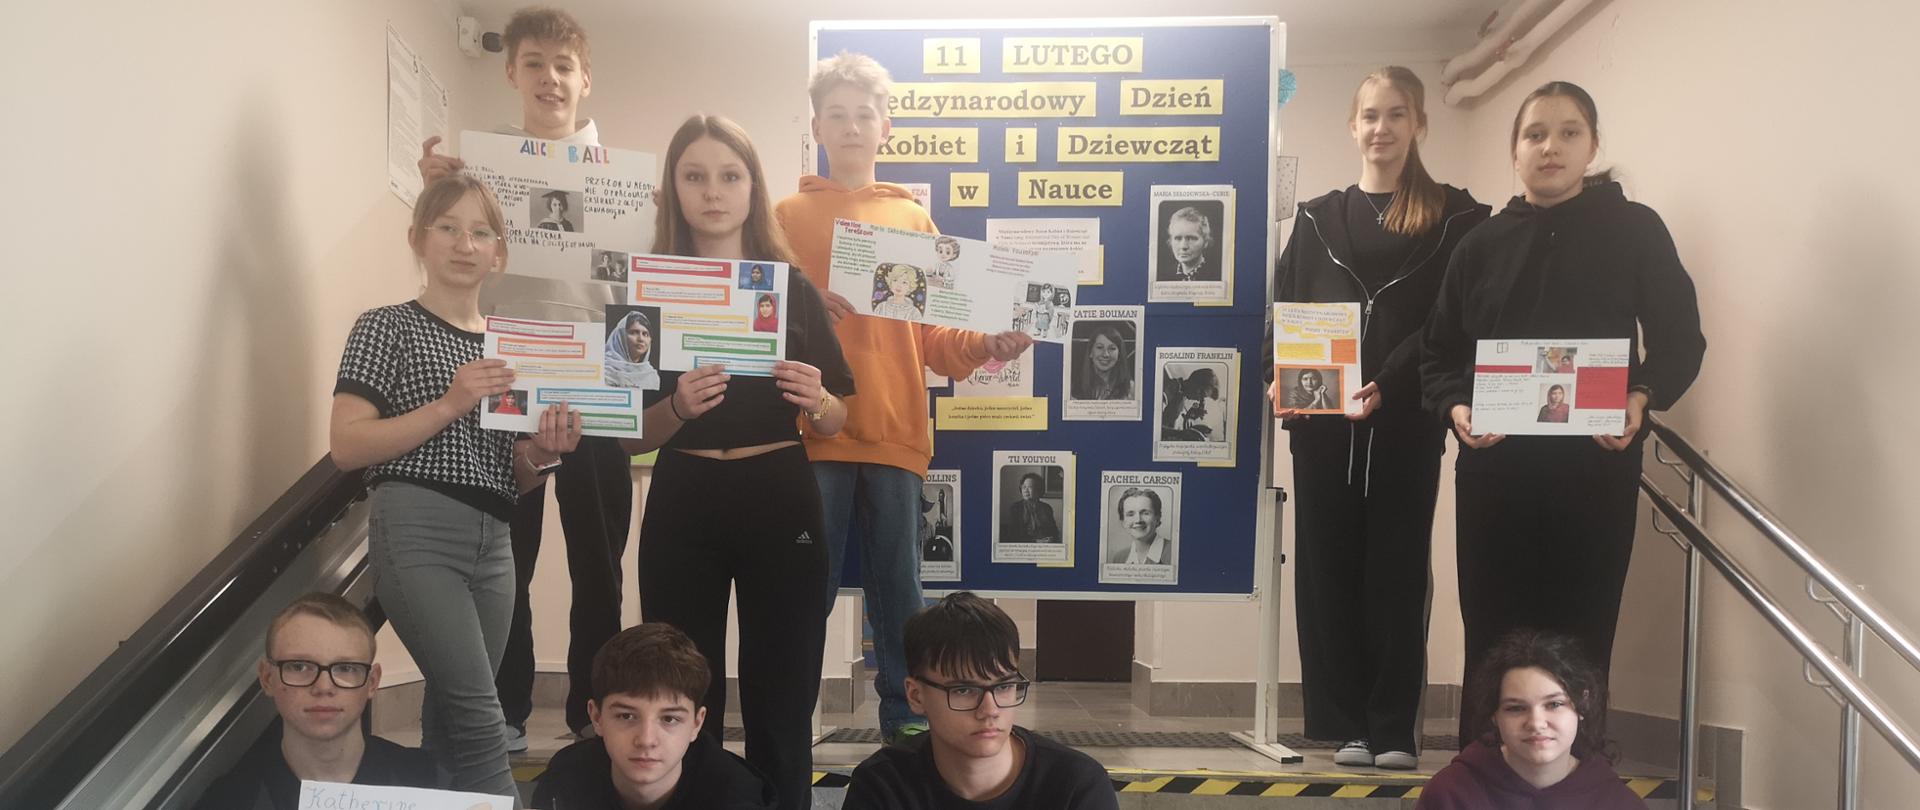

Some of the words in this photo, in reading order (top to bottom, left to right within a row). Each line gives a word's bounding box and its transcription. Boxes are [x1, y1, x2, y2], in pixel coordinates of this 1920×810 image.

[937, 46, 967, 66] 11
[1013, 44, 1133, 66] LUTEGO
[887, 89, 1085, 116] ędzynarodowy
[1131, 86, 1212, 108] Dzień
[520, 139, 555, 159] ALICE
[568, 145, 610, 164] BALL
[876, 134, 966, 156] Kobiet
[1016, 134, 1025, 156] i
[1068, 134, 1212, 159] Dziewcząt
[957, 185, 979, 200] w
[1029, 179, 1113, 200] Nauce
[1099, 310, 1138, 318] BOUMAN
[1159, 352, 1196, 360] ROSALIND
[1197, 352, 1233, 360] FRANKLIN
[1007, 455, 1020, 463] TU
[1022, 455, 1057, 464] YOUYOU
[925, 475, 957, 483] OLLINS
[1103, 474, 1142, 484] RACHEL
[1143, 475, 1180, 485] CARSON
[304, 786, 416, 810] Katherine
